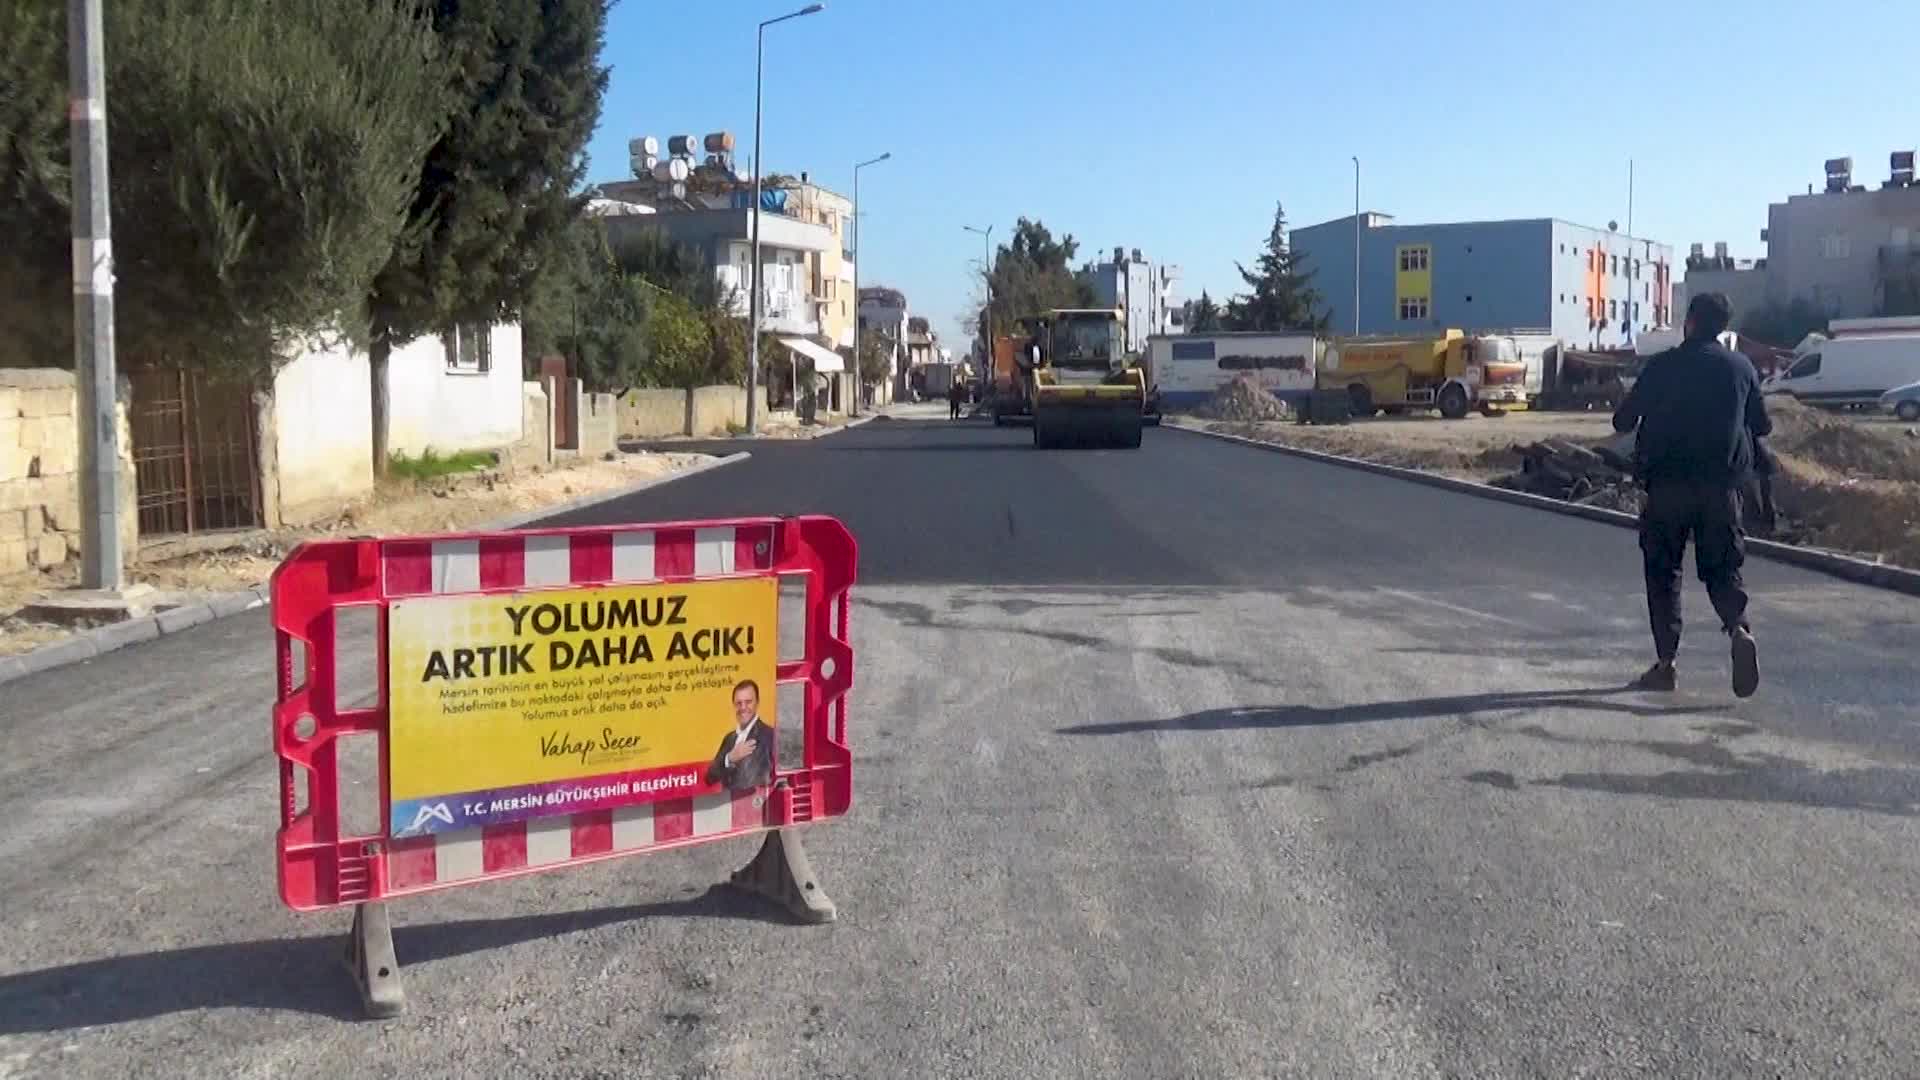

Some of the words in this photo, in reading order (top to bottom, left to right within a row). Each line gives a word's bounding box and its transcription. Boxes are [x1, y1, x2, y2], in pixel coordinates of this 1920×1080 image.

[505, 595, 688, 636] YOLUMUZ
[422, 643, 536, 682] ARTIK
[549, 633, 654, 672] DAHA
[666, 625, 755, 662] AÇIK!
[438, 687, 479, 700] Mersin
[483, 681, 531, 696] tarihinin
[535, 682, 549, 690] en
[552, 675, 585, 690] büyük
[588, 673, 605, 687] yol
[442, 701, 507, 715] hedefimize
[511, 698, 525, 708] bu
[528, 692, 584, 706] noktadaki
[645, 682, 672, 694] daha
[674, 681, 689, 692] da
[521, 710, 569, 721] Yolumuz
[571, 704, 595, 717] artık
[598, 701, 627, 713] daha
[629, 699, 643, 711] da
[540, 730, 596, 766] Vahap
[463, 803, 488, 816] T.C.
[490, 793, 543, 813] MERSİN
[546, 781, 630, 804] BÜYÜKŞEHİR
[632, 771, 698, 794] BELEDİYESİ
